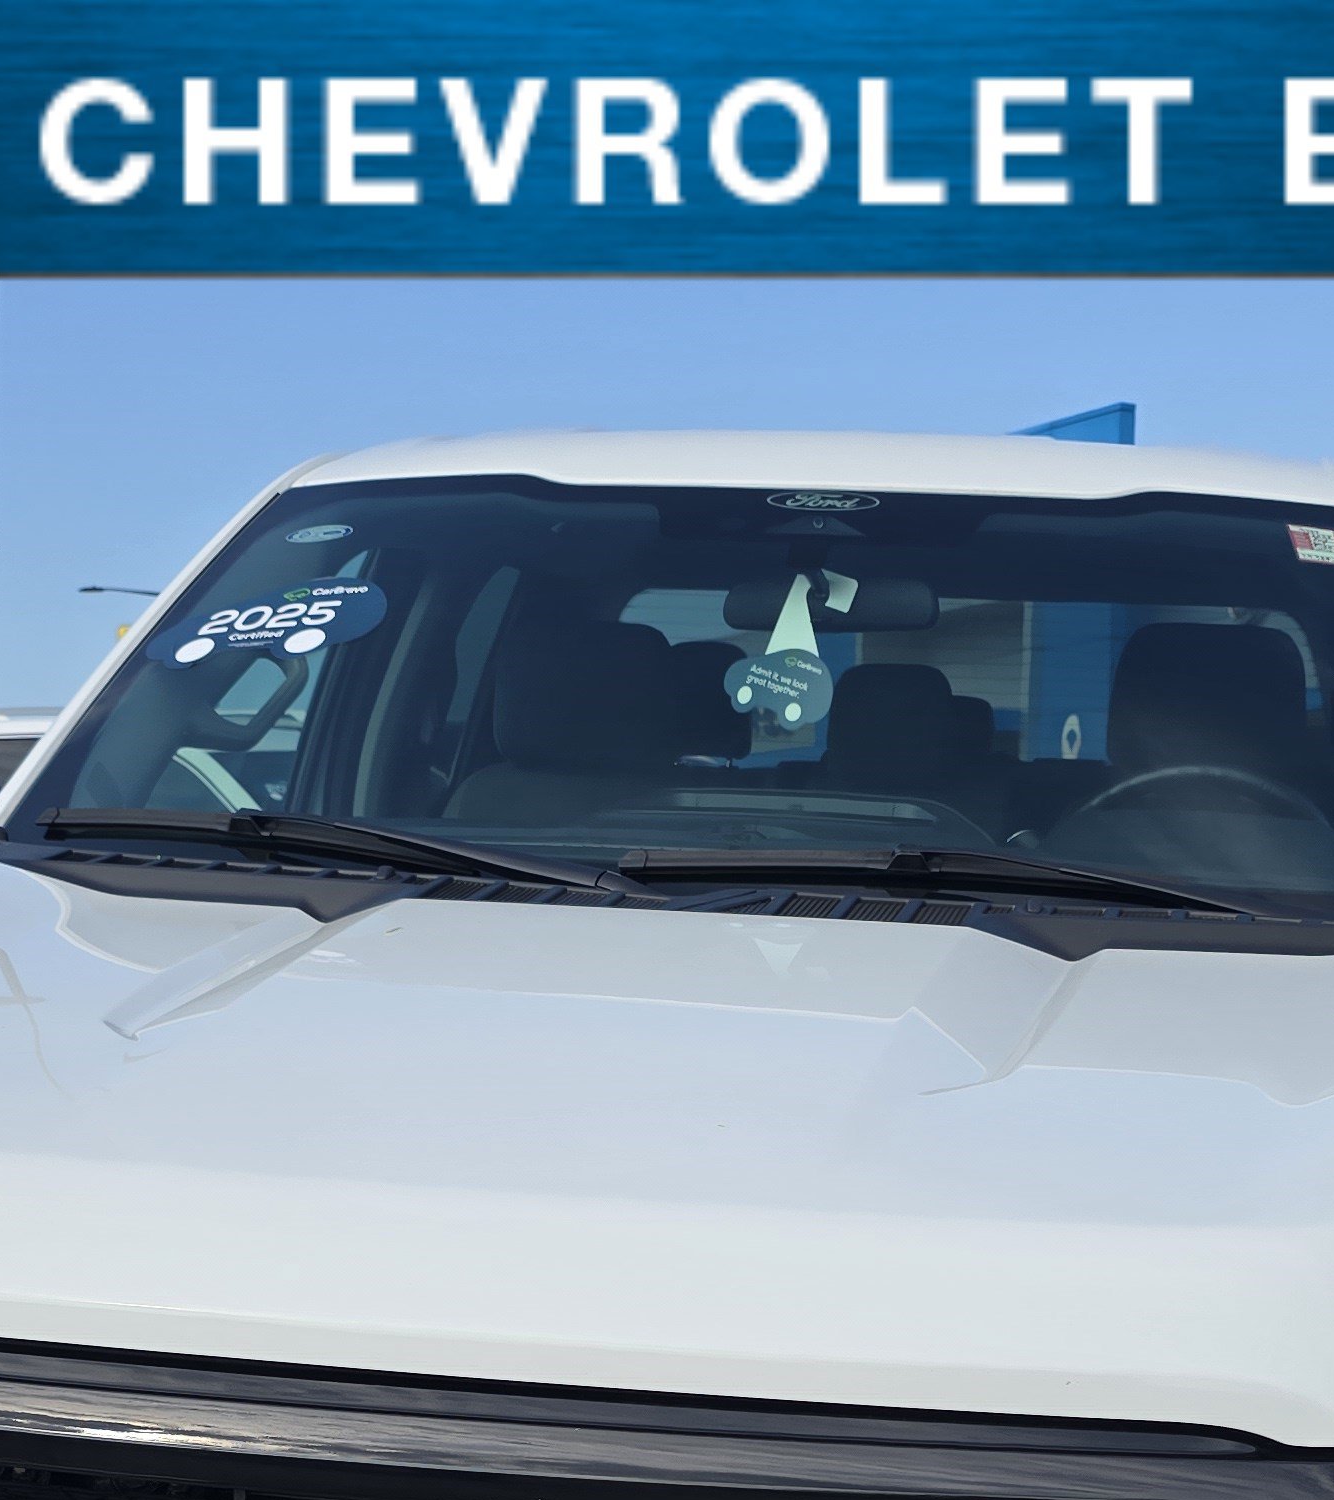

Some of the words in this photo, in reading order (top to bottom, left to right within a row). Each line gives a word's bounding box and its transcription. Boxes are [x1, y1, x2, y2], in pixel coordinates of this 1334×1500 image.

[786, 493, 860, 508] Ford
[198, 600, 342, 635] 2025
[228, 629, 285, 642] Certified
[746, 675, 766, 687] great
[767, 681, 799, 698] together.
[750, 664, 772, 678] Admit
[792, 678, 807, 691] look
